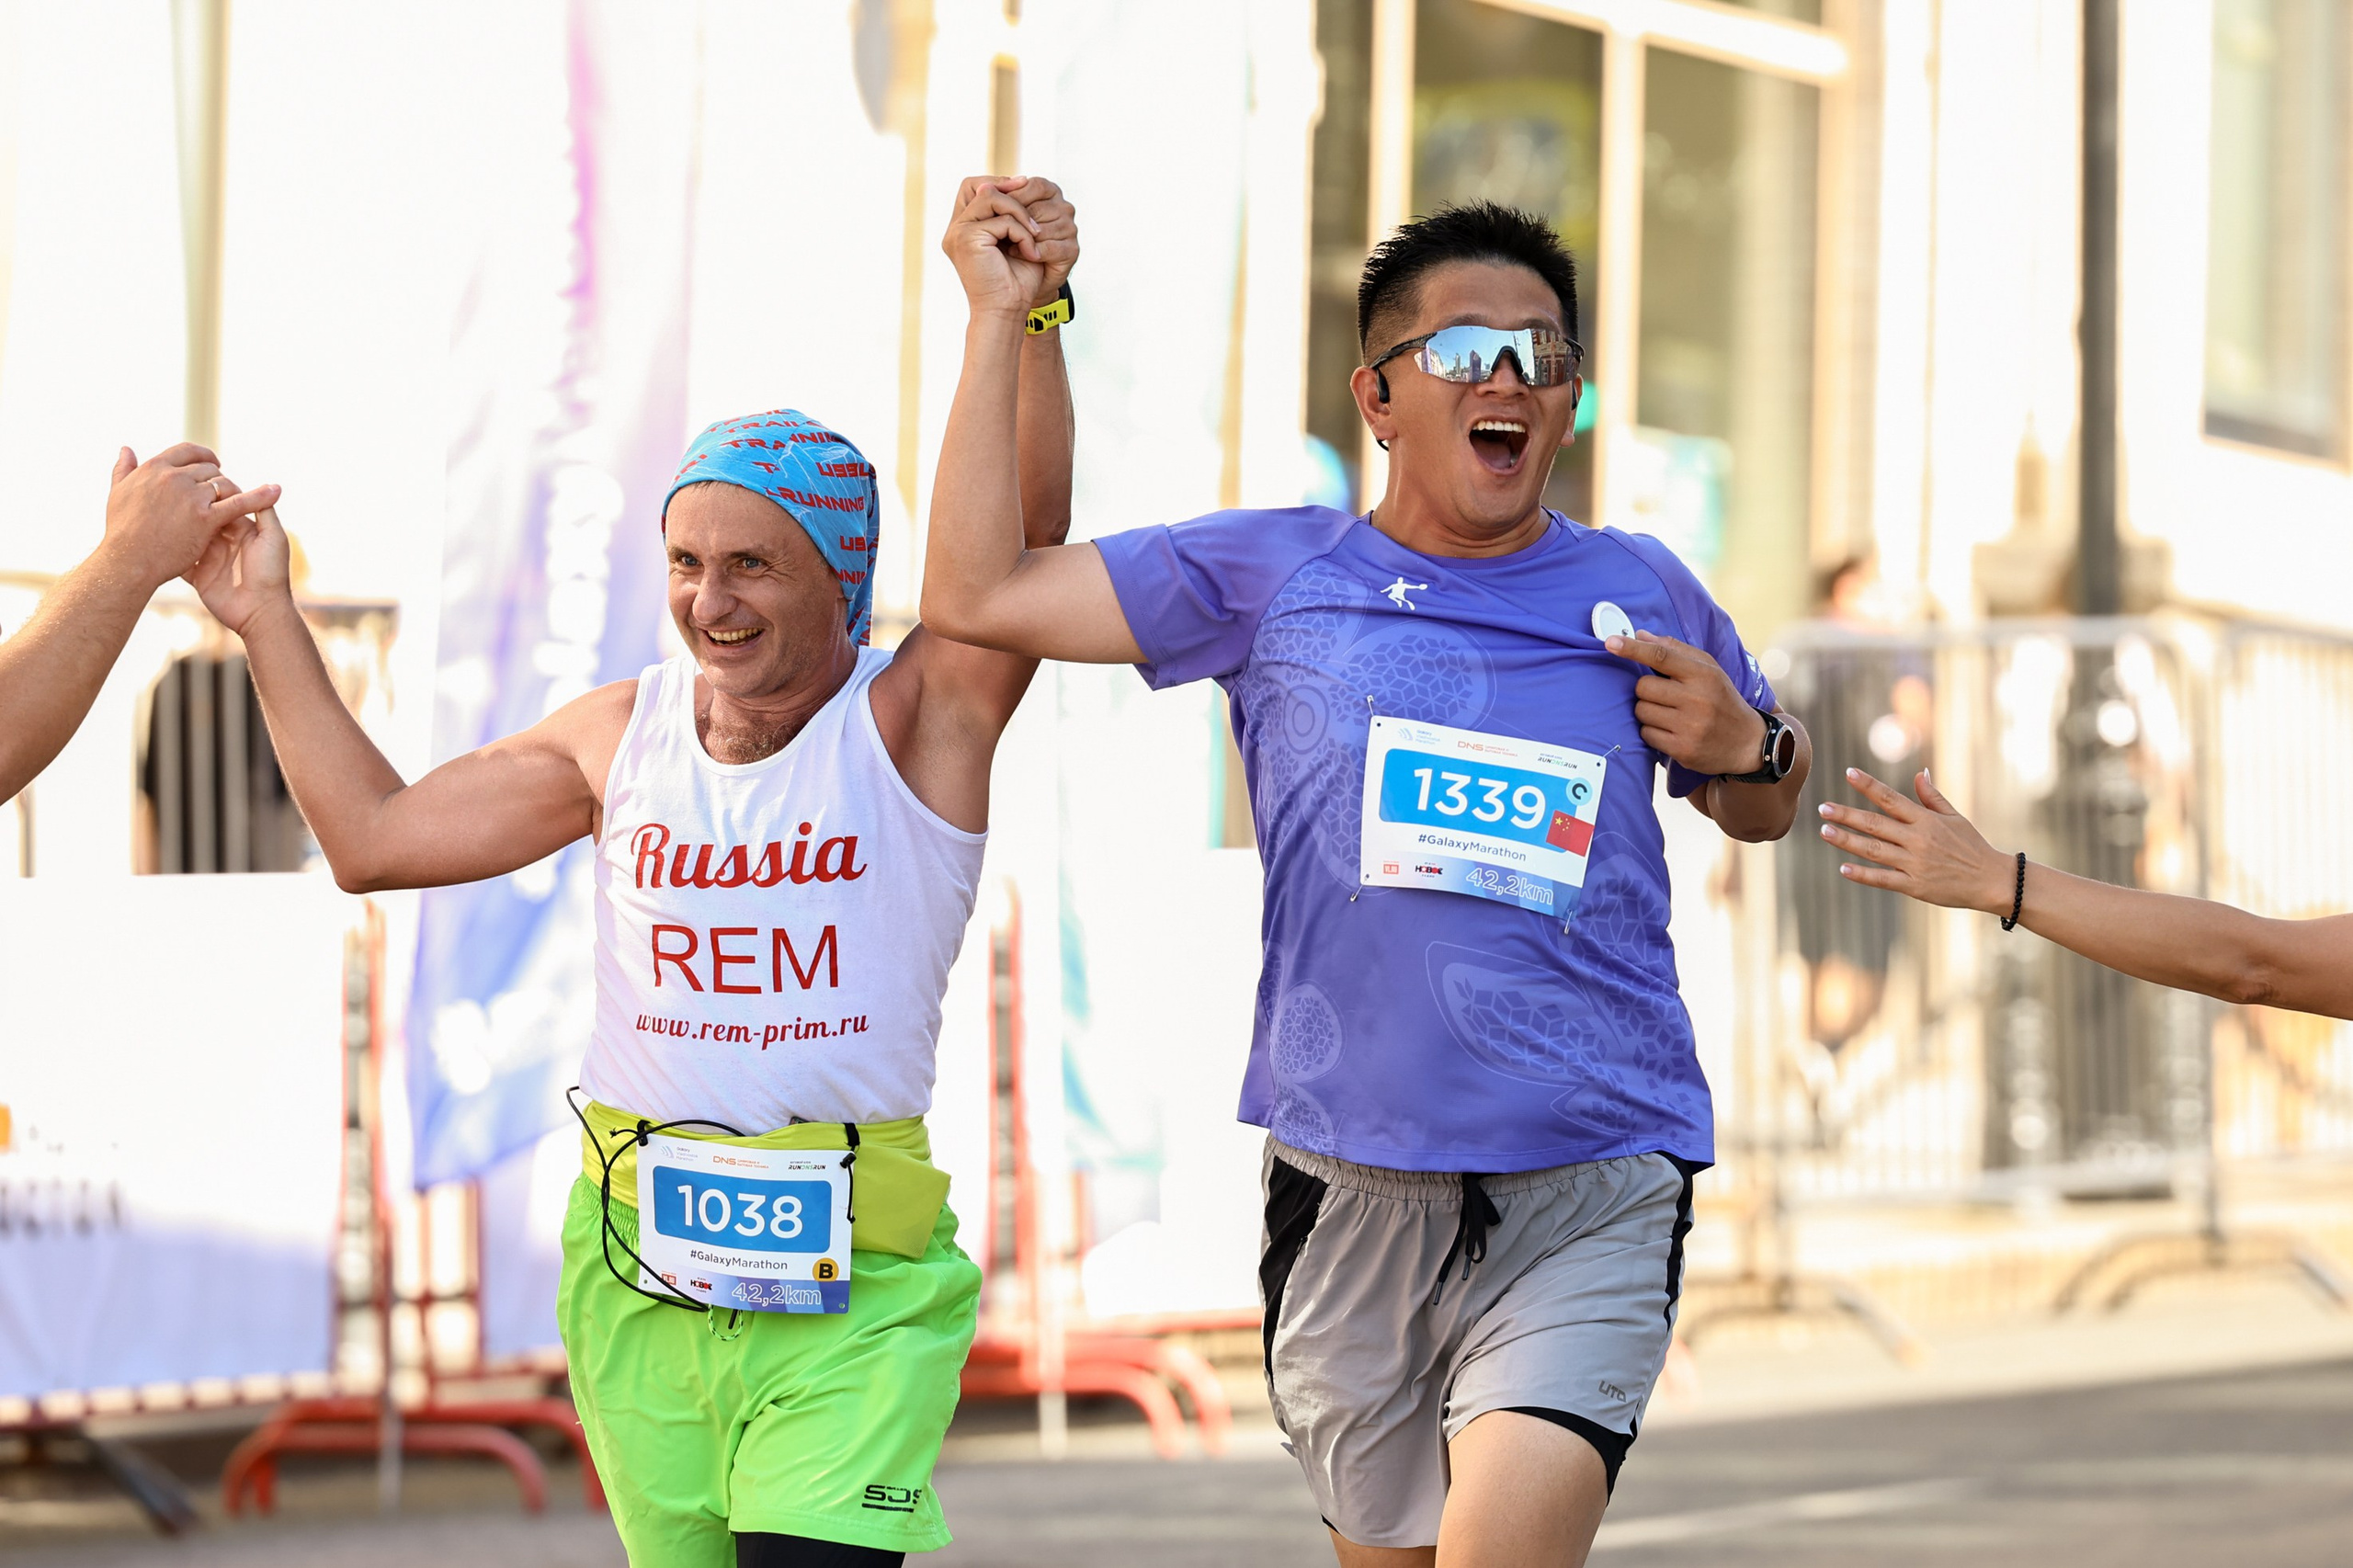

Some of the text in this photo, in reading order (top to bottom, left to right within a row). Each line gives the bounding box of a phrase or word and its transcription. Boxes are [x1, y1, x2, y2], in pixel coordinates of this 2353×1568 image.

[777, 486, 865, 513] RUNNING
[1457, 741, 1484, 752] DNS
[1414, 767, 1546, 830] 1339
[631, 822, 868, 889] Russia
[1418, 834, 1526, 862] #GalaxyMarathon
[1466, 867, 1553, 905] 42,2km
[652, 925, 838, 994] REM
[635, 1014, 870, 1051] www.rem-prim.ru
[712, 1155, 737, 1166] DNS
[676, 1184, 803, 1239] 1038
[690, 1249, 788, 1270] #GalaxyMarathon
[819, 1263, 834, 1279] B
[732, 1282, 822, 1306] 42,2km
